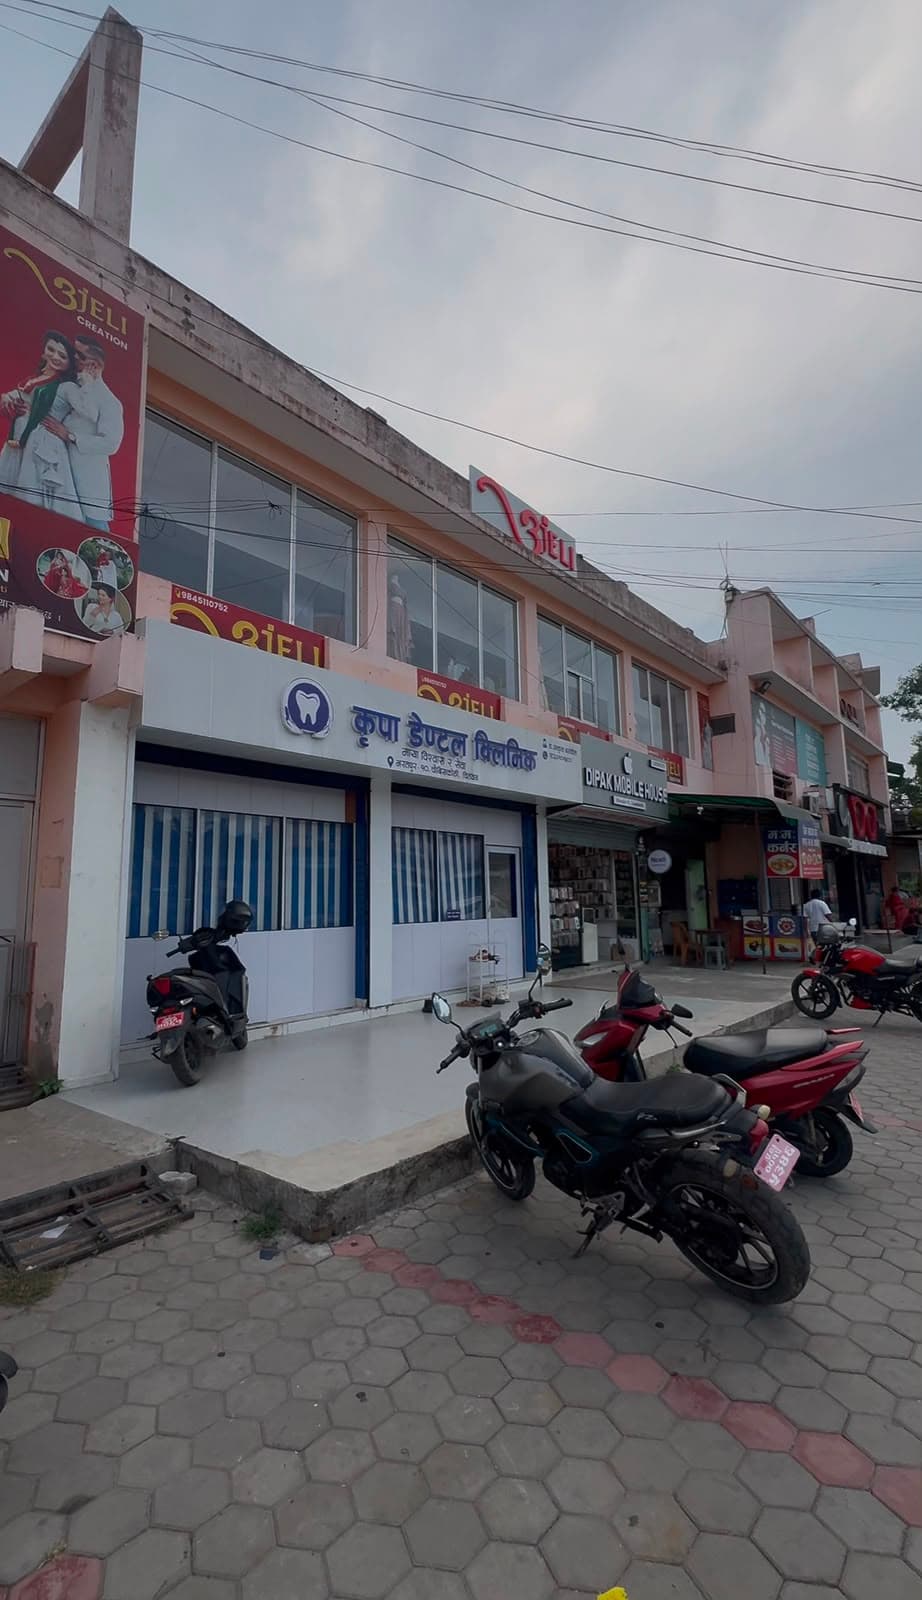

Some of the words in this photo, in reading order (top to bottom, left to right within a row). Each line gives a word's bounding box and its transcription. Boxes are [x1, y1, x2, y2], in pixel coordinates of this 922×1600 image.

[76, 315, 128, 351] CREATION
[181, 590, 229, 613] 9845110752
[350, 705, 401, 748] कृपा
[474, 730, 538, 772] क्लिनिक
[585, 768, 613, 791] DIPAK
[613, 775, 643, 798] MOBILE
[644, 783, 668, 804] HOUSE
